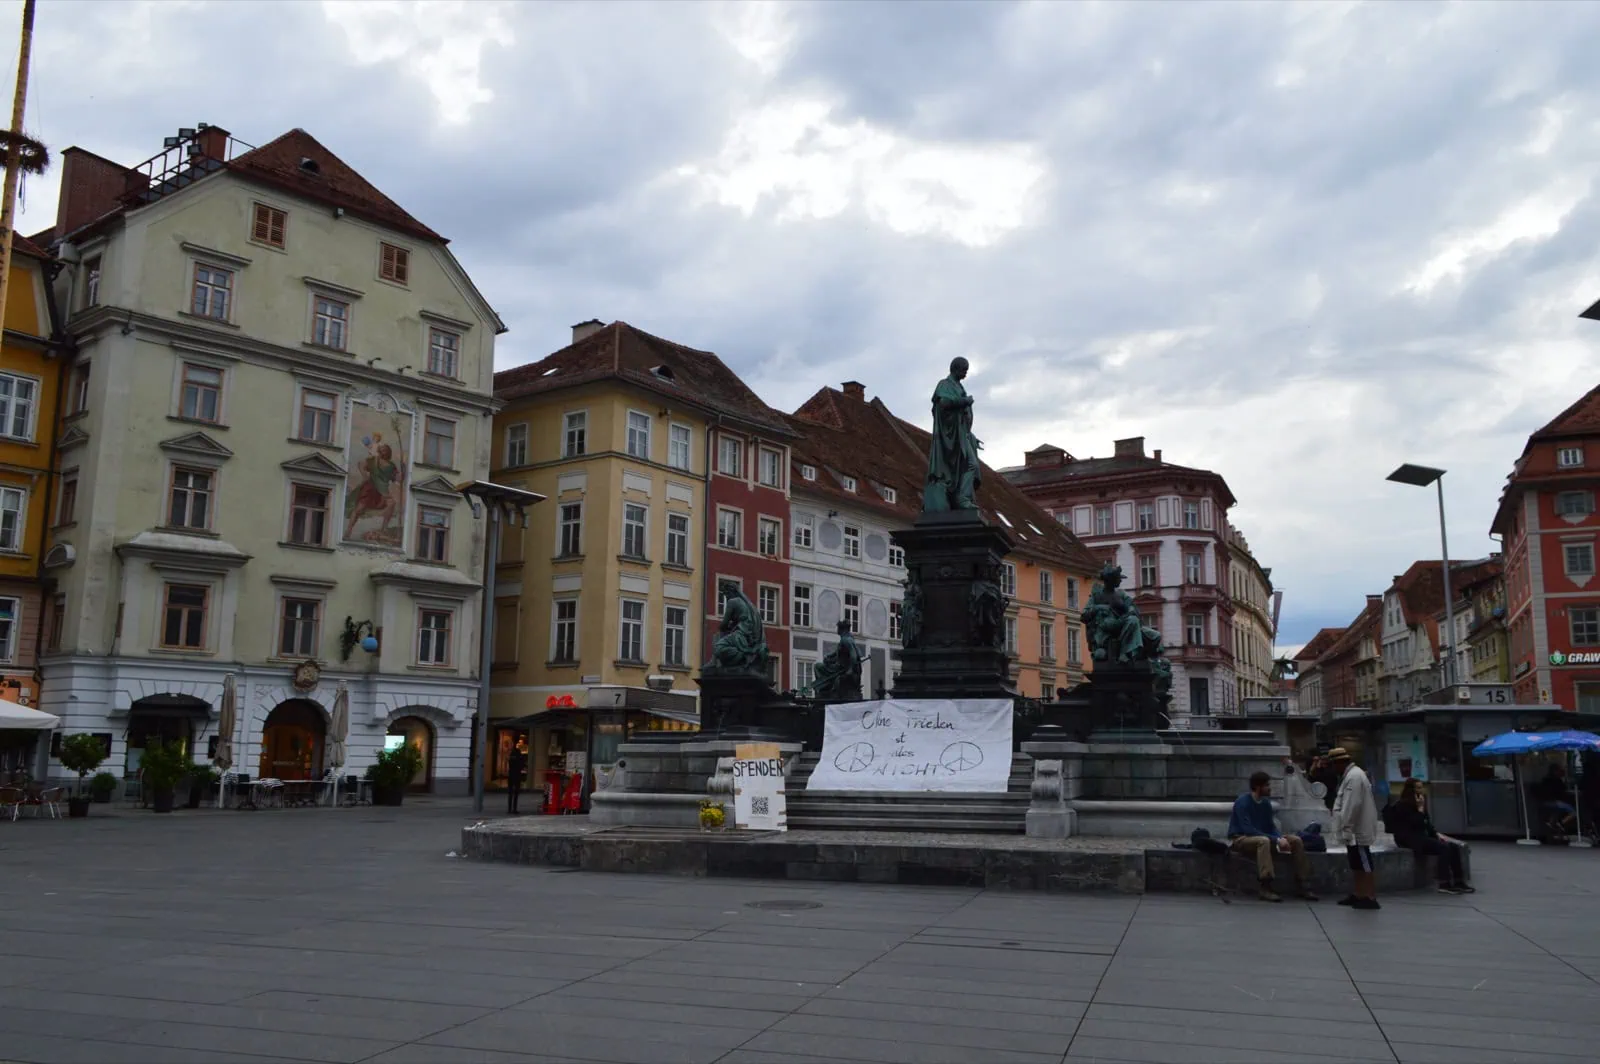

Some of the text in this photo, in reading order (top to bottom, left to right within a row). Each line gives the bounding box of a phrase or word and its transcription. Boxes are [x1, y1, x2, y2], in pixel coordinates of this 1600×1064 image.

[614, 693, 621, 704] 7
[1486, 690, 1505, 704] 15
[1268, 702, 1282, 713] 14
